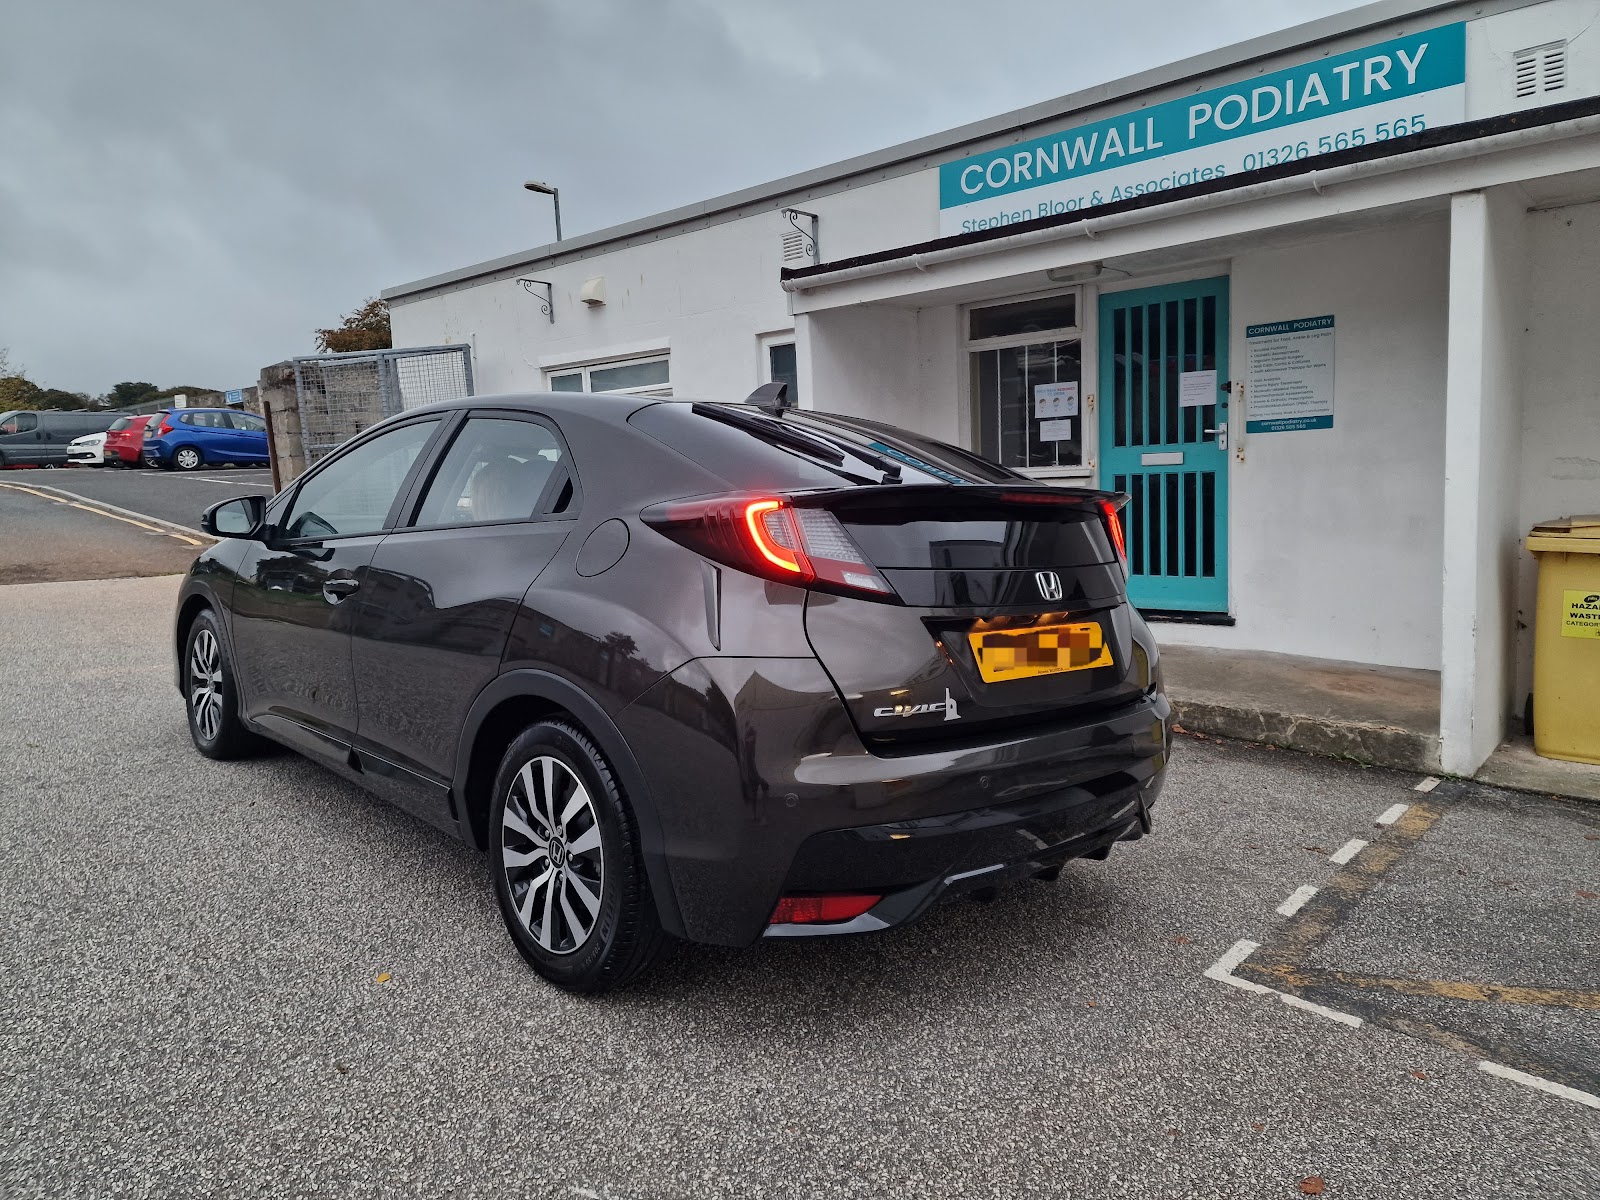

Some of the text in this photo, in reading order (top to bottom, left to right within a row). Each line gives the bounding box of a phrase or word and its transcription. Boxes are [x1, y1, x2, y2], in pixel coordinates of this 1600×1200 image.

[960, 43, 1429, 195] CORNWALL PODIATRY
[961, 113, 1427, 235] Stephen Bloor & Associates 01326 565 565
[1248, 318, 1332, 335] CORNWALL PODIATRY
